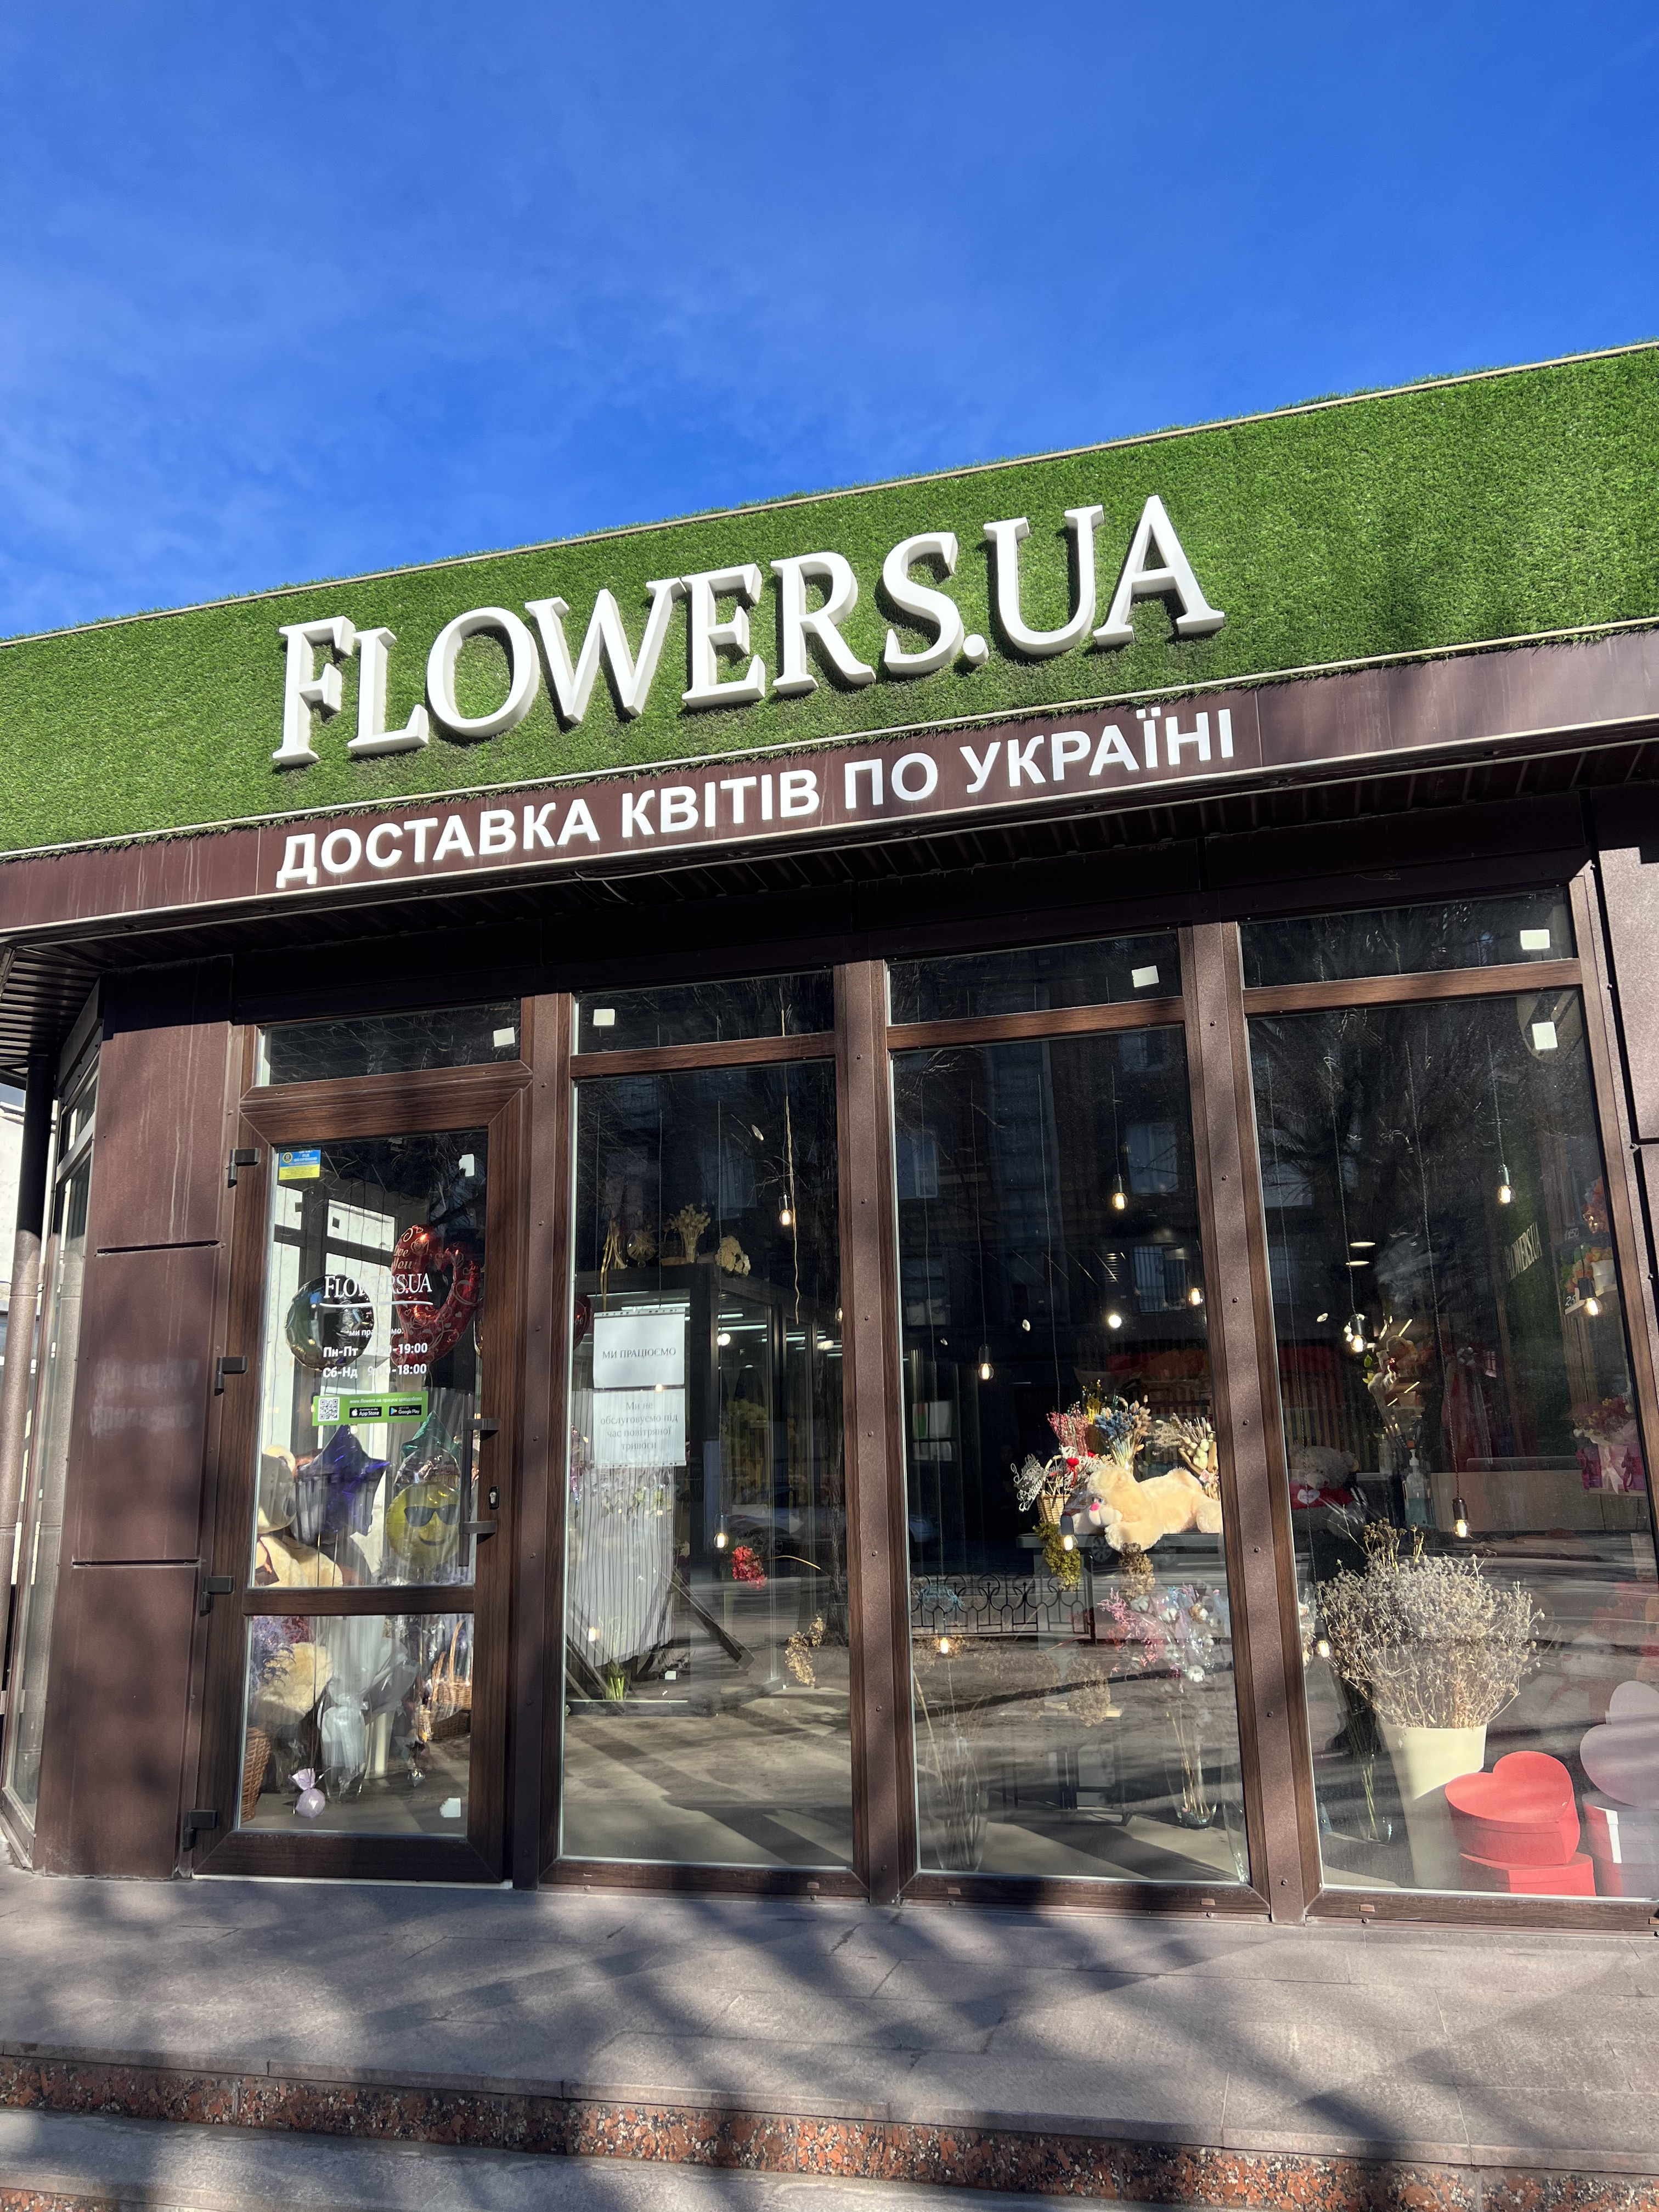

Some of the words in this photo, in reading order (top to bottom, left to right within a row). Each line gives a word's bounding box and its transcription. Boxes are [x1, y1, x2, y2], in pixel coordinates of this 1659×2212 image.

[272, 495, 1225, 766] FLOWERS.UA
[276, 799, 600, 889] ДОСТАВКА
[622, 769, 820, 838] КВІТІВ
[843, 751, 939, 811] ПО
[963, 708, 1234, 795] УКРАЇНІ
[323, 1346, 358, 1357] Пн-Пт
[368, 1342, 428, 1356] :00-19:00
[602, 1351, 617, 1359] МИ
[620, 1347, 676, 1358] ПРАЦЮЄМО
[323, 1366, 358, 1379] Сб-Нд
[626, 1402, 640, 1410] Ми
[600, 1414, 661, 1425] обслуговуємо
[664, 1413, 678, 1423] під
[624, 1427, 671, 1437] повітряної
[621, 1442, 657, 1453] тривоги
